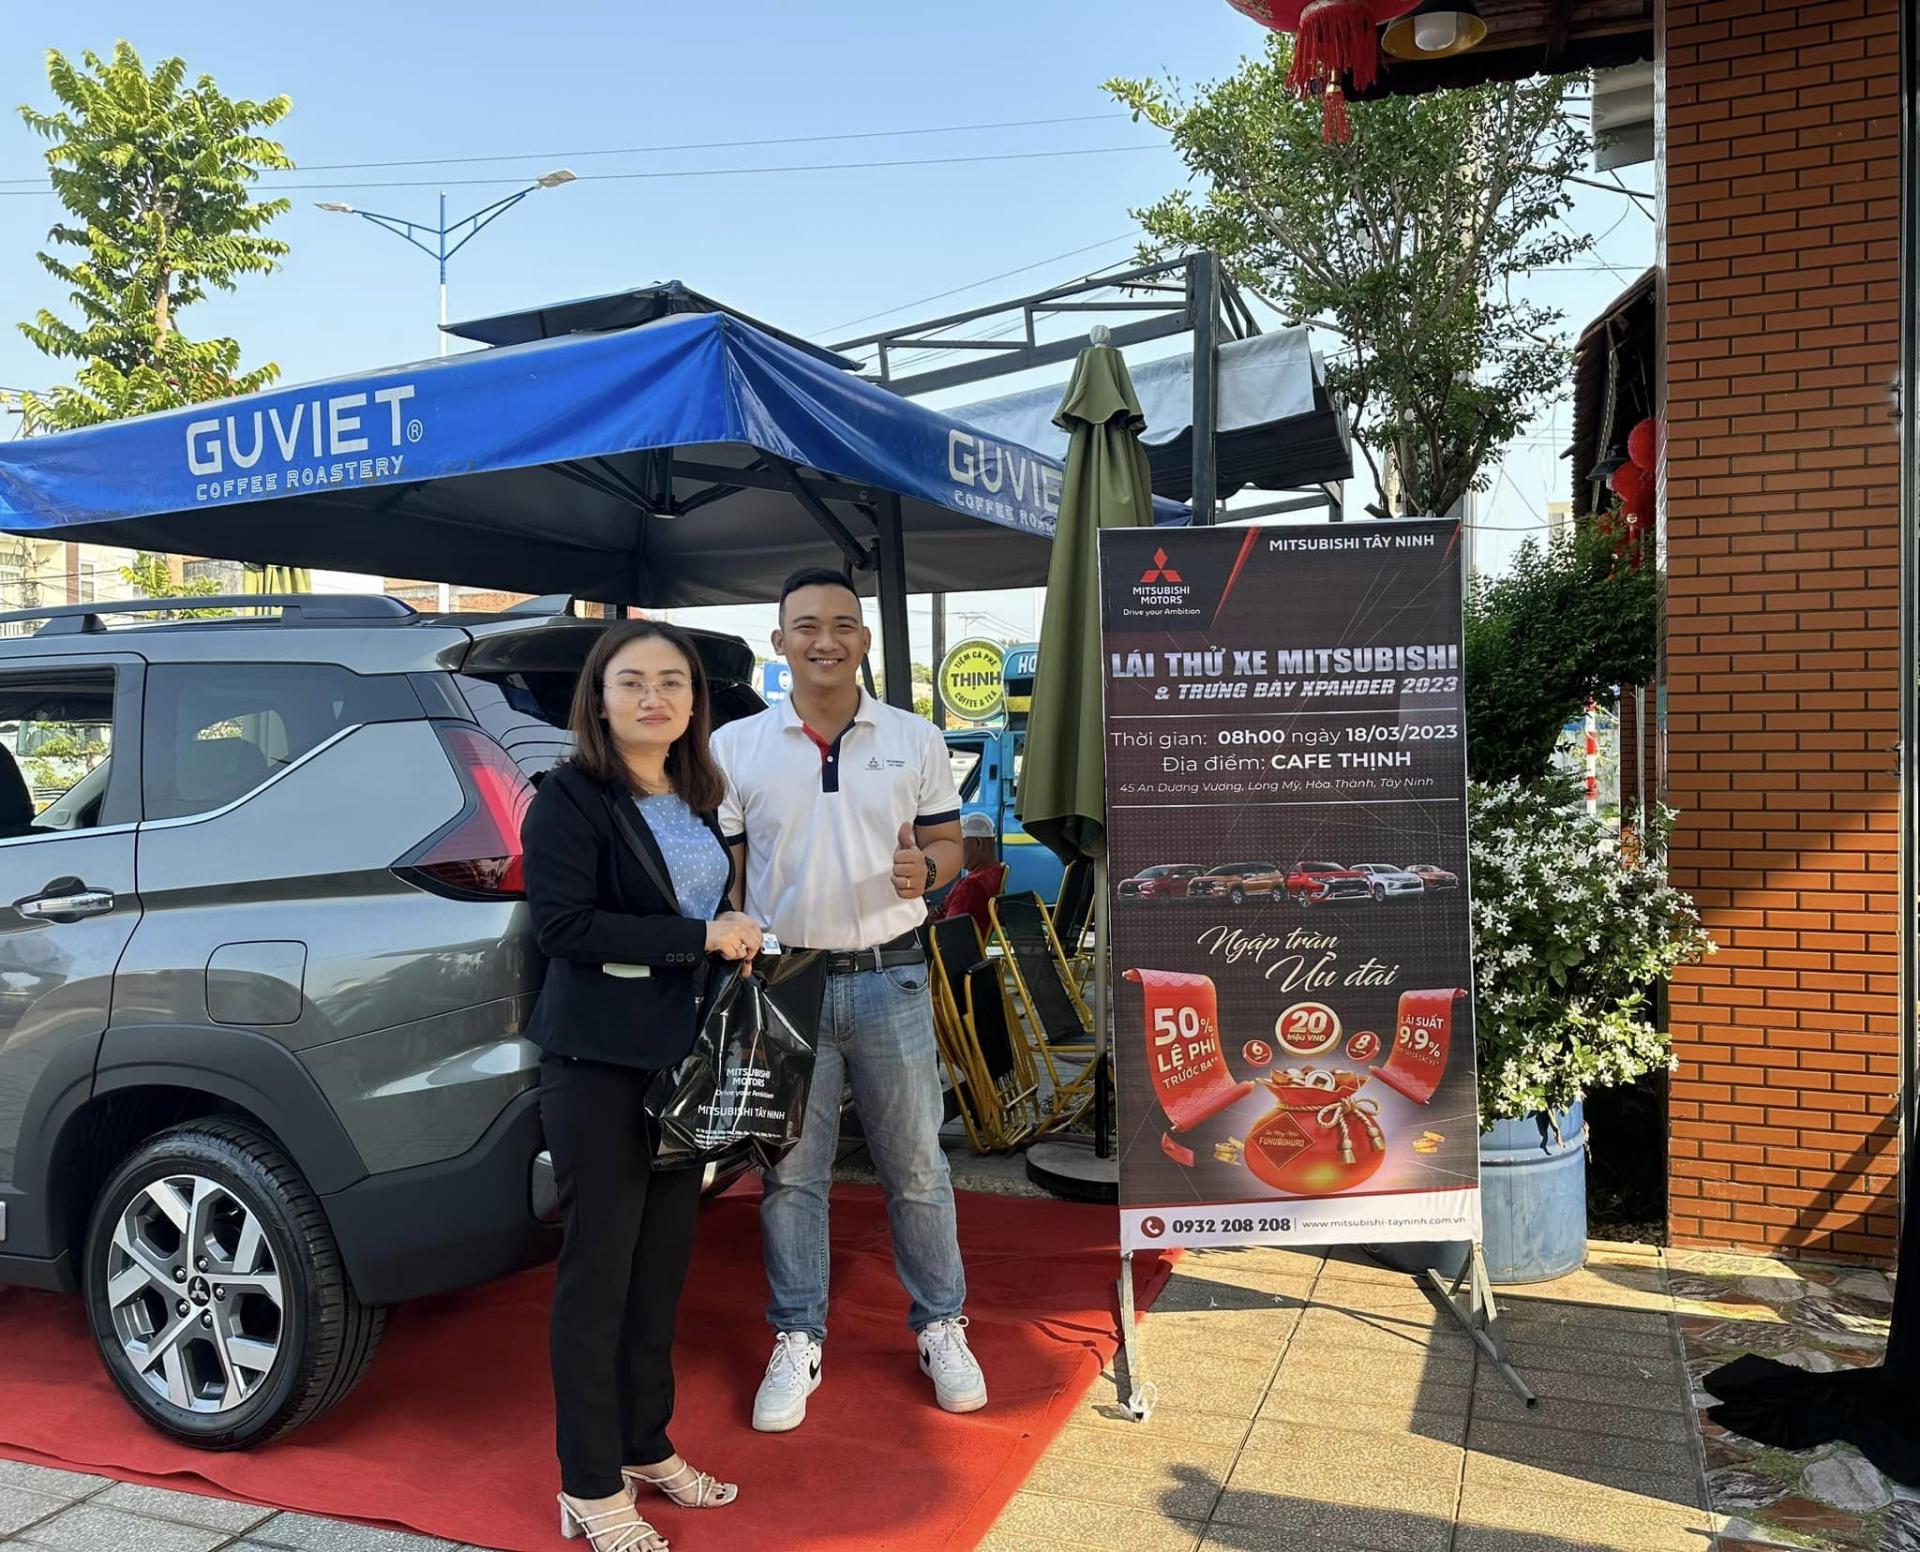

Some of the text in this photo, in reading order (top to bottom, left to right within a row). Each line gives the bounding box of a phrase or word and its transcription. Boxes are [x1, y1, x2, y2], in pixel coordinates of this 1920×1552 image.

[196, 455, 404, 501] COFFEE ROASTERY
[954, 489, 1014, 521] COFFEE
[1269, 534, 1434, 551] MITSUBISHI TÂY NINH
[1132, 586, 1190, 595] MITSUBISHI
[1141, 595, 1183, 605] MOTORS
[1123, 607, 1200, 617] Drive your Ambition
[1111, 645, 1458, 678] LÁI THỬ XE MITSUBISHI
[951, 670, 1001, 690] THỊNH
[1154, 676, 1459, 700] & TRƯNG BÀY XPANDER 2023
[954, 691, 978, 708] COFFEE
[984, 690, 997, 703] TEA
[1110, 724, 1458, 749] Thời gian: 08h00 ngày 18/03/2023
[1161, 751, 1411, 775] Địa điểm: CAFE THỊNH
[1120, 783, 1135, 793] 45
[1136, 783, 1154, 792] An
[1248, 781, 1279, 792] Long
[1404, 776, 1434, 787] Ninh
[1197, 925, 1340, 964] Ngập tràn
[1343, 957, 1401, 987] đãi
[1153, 1006, 1214, 1047] 50%
[1288, 1010, 1329, 1034] 20
[1415, 1013, 1445, 1029] SUẤT
[1251, 1042, 1263, 1056] 6
[1355, 1034, 1371, 1050] 8
[1399, 1025, 1441, 1058] 9,9%
[1157, 1033, 1216, 1073] LỆ PHÍ
[726, 1068, 771, 1079] MITSUBISHI
[732, 1077, 765, 1087] MOTORS
[697, 1104, 785, 1120] MITSUBISHI TÂY NINH
[1172, 1218, 1291, 1234] 0932 208 208
[1302, 1215, 1466, 1230] www.mitsubishi-tayninh.com.vn
